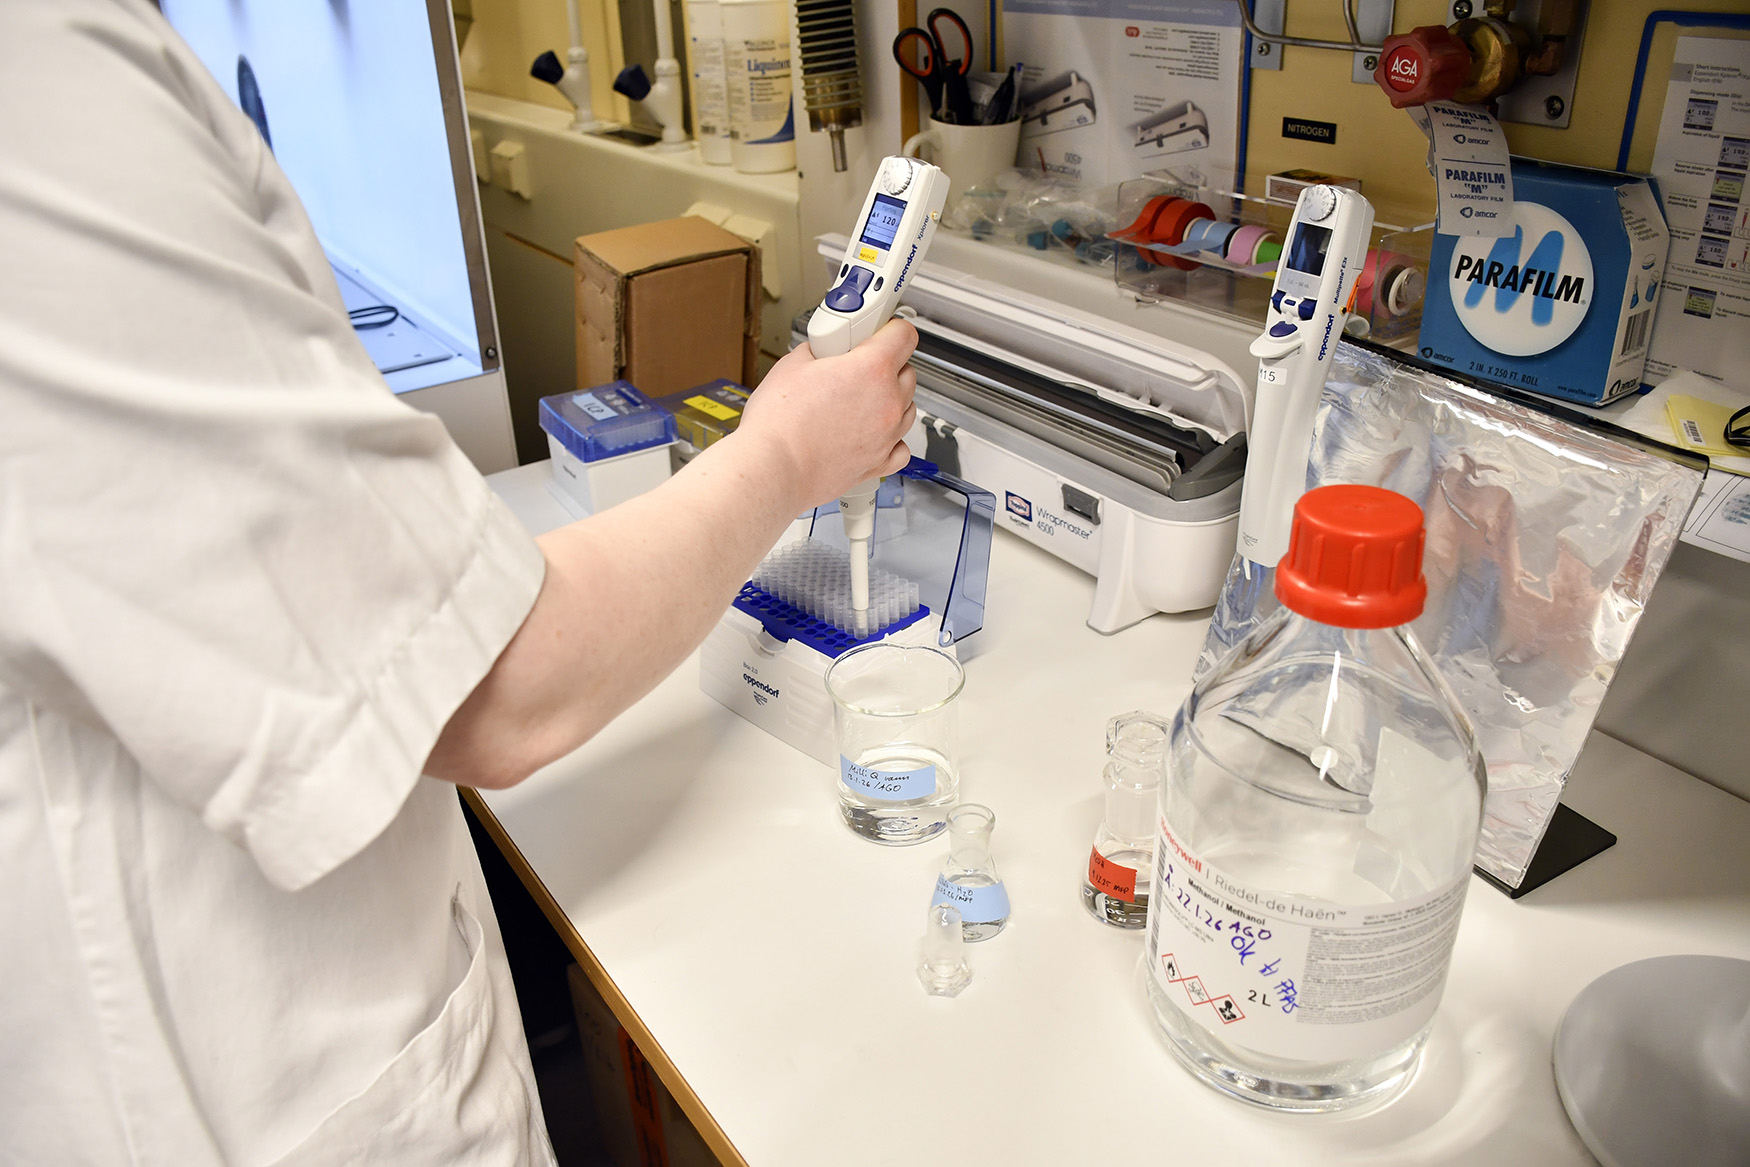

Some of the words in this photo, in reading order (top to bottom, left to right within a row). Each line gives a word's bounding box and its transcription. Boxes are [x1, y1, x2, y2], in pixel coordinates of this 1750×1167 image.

[1391, 55, 1418, 78] AGA
[1390, 74, 1415, 85] SPECIALGAS
[1433, 105, 1490, 122] PARAFILM
[1287, 124, 1330, 137] NITROGEN
[1442, 122, 1479, 131] LABORATORY
[1467, 136, 1490, 145] amcor
[1445, 168, 1506, 184] PARAFILM
[1450, 193, 1489, 202] LABORATORY
[882, 215, 896, 226] 120
[1474, 209, 1497, 219] amcor
[917, 215, 930, 241] Xplorer
[893, 243, 918, 293] eppendorf
[1454, 254, 1585, 304] PARAFILM
[1318, 314, 1335, 362] eppendorf
[1433, 353, 1455, 364] amcor
[1469, 361, 1475, 371] 2
[1475, 362, 1486, 373] IN.
[1487, 366, 1493, 375] X
[1494, 367, 1508, 379] 250
[1509, 371, 1519, 382] FT.
[1521, 374, 1539, 387] ROLL
[1036, 505, 1090, 540] Wrapmaster
[1036, 520, 1055, 536] 4500
[743, 673, 780, 698] eppendorf
[869, 771, 879, 780] Q
[1188, 877, 1220, 905] Methanol
[1225, 903, 1266, 926] Methanol
[1215, 874, 1286, 913] Riedel-de
[1228, 920, 1272, 941] AGO
[1230, 935, 1256, 966] OK
[1247, 989, 1257, 1003] 2
[1262, 993, 1271, 1007] L
